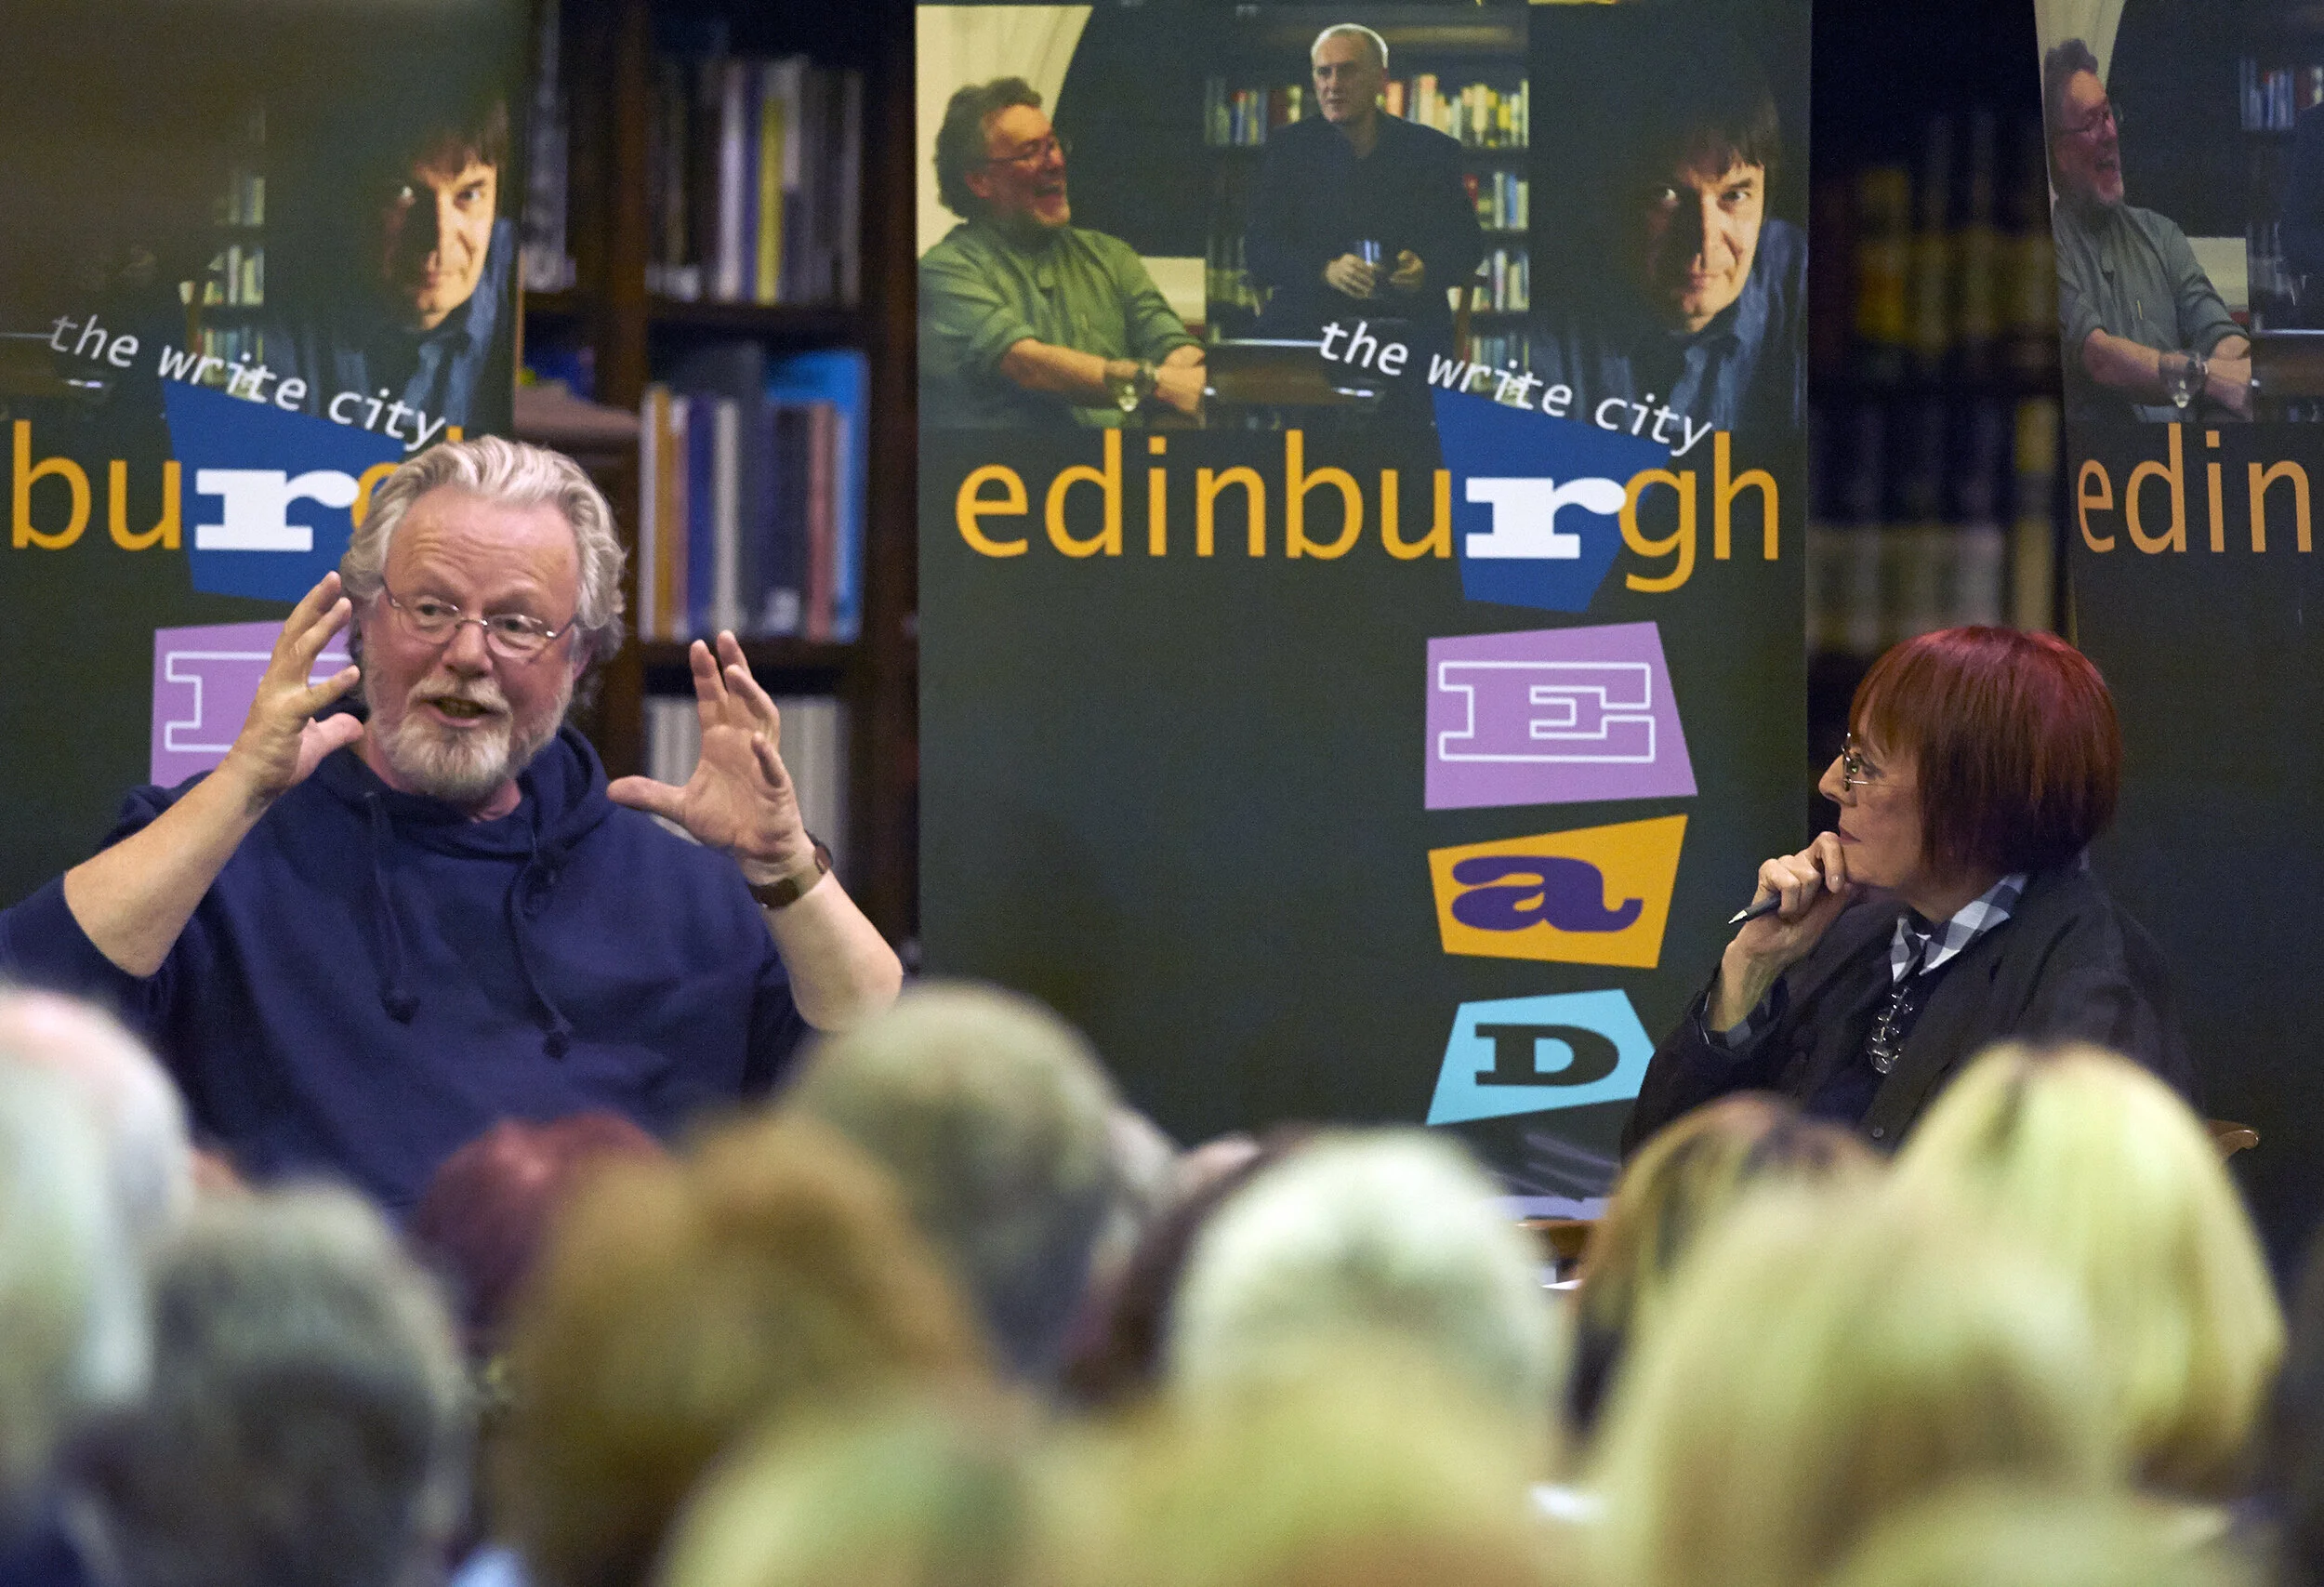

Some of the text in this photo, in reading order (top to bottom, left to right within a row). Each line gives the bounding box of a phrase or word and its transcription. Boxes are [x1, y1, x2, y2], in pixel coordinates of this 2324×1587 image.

[49, 314, 447, 452] the write city
[1318, 322, 1713, 456] the write city
[956, 429, 1779, 593] edinburgh
[2078, 422, 2312, 554] edin
